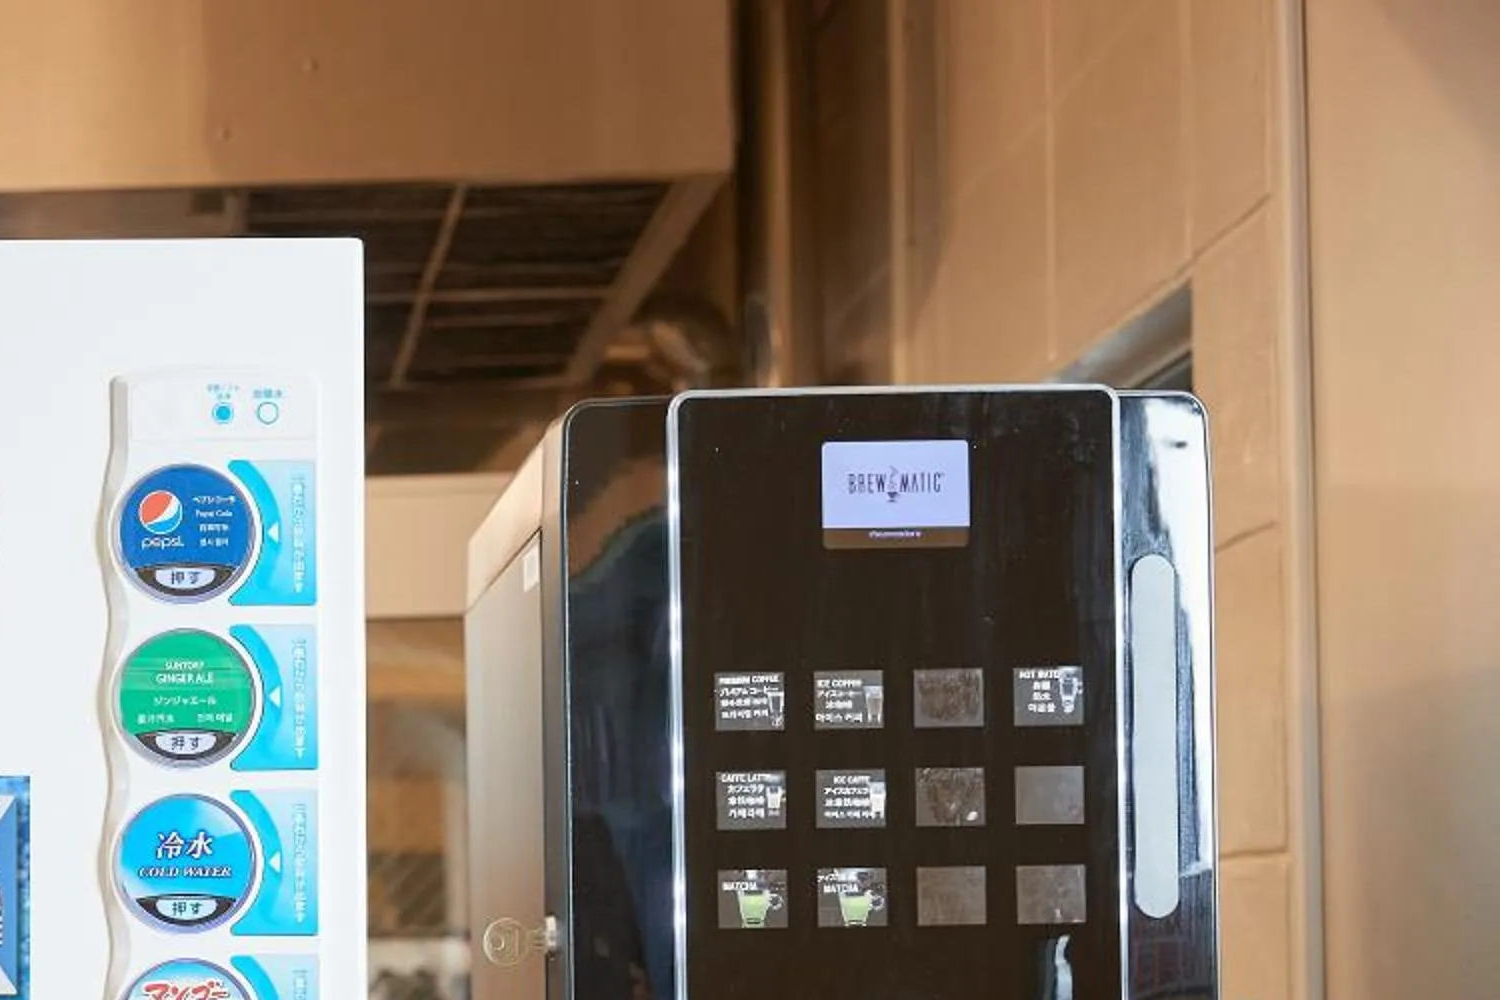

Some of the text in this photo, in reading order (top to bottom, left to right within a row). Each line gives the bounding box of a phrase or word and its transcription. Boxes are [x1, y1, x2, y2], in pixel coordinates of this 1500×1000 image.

[171, 571, 201, 585] 押す
[171, 736, 201, 750] 押す
[156, 831, 213, 859] 冷水
[138, 866, 232, 878] COLD WATER
[172, 902, 202, 915] 押す
